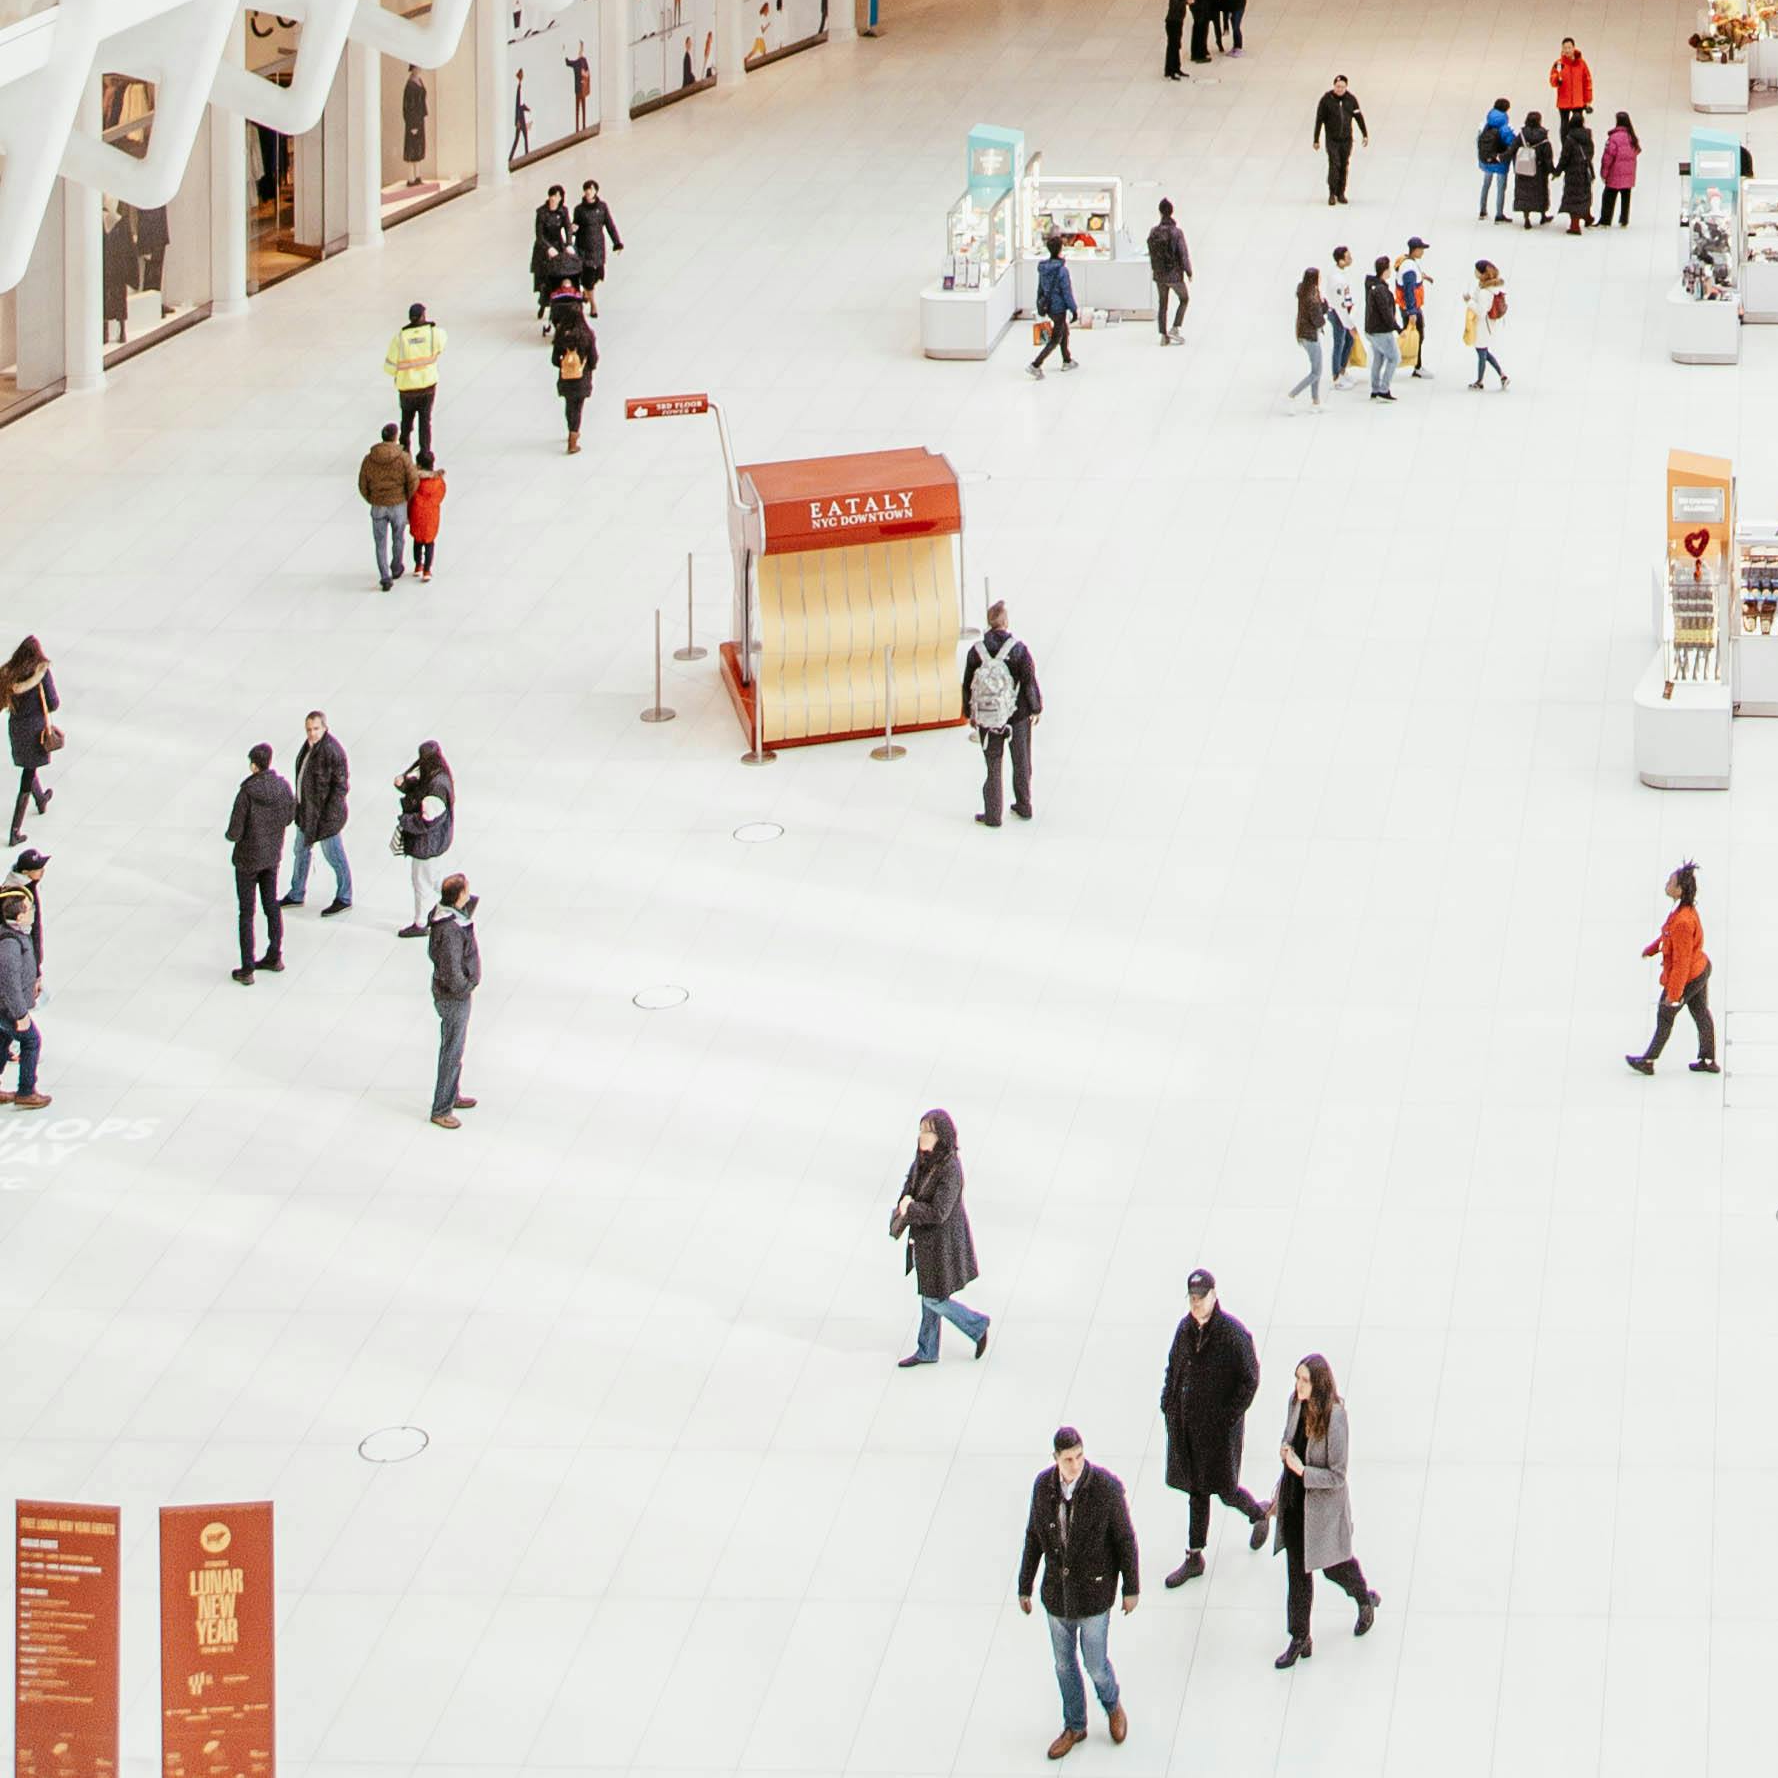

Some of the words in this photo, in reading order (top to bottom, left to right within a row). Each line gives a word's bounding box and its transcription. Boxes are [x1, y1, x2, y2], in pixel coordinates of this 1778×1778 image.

[674, 400, 702, 410] FLOOR
[809, 490, 913, 519] EATALY
[811, 516, 838, 530] NYC
[840, 508, 913, 526] DOWNTOWN
[0, 1118, 164, 1141] HOPS
[189, 1568, 244, 1596] LUNAR
[197, 1593, 237, 1619] NEW
[195, 1616, 240, 1646] YEAR
